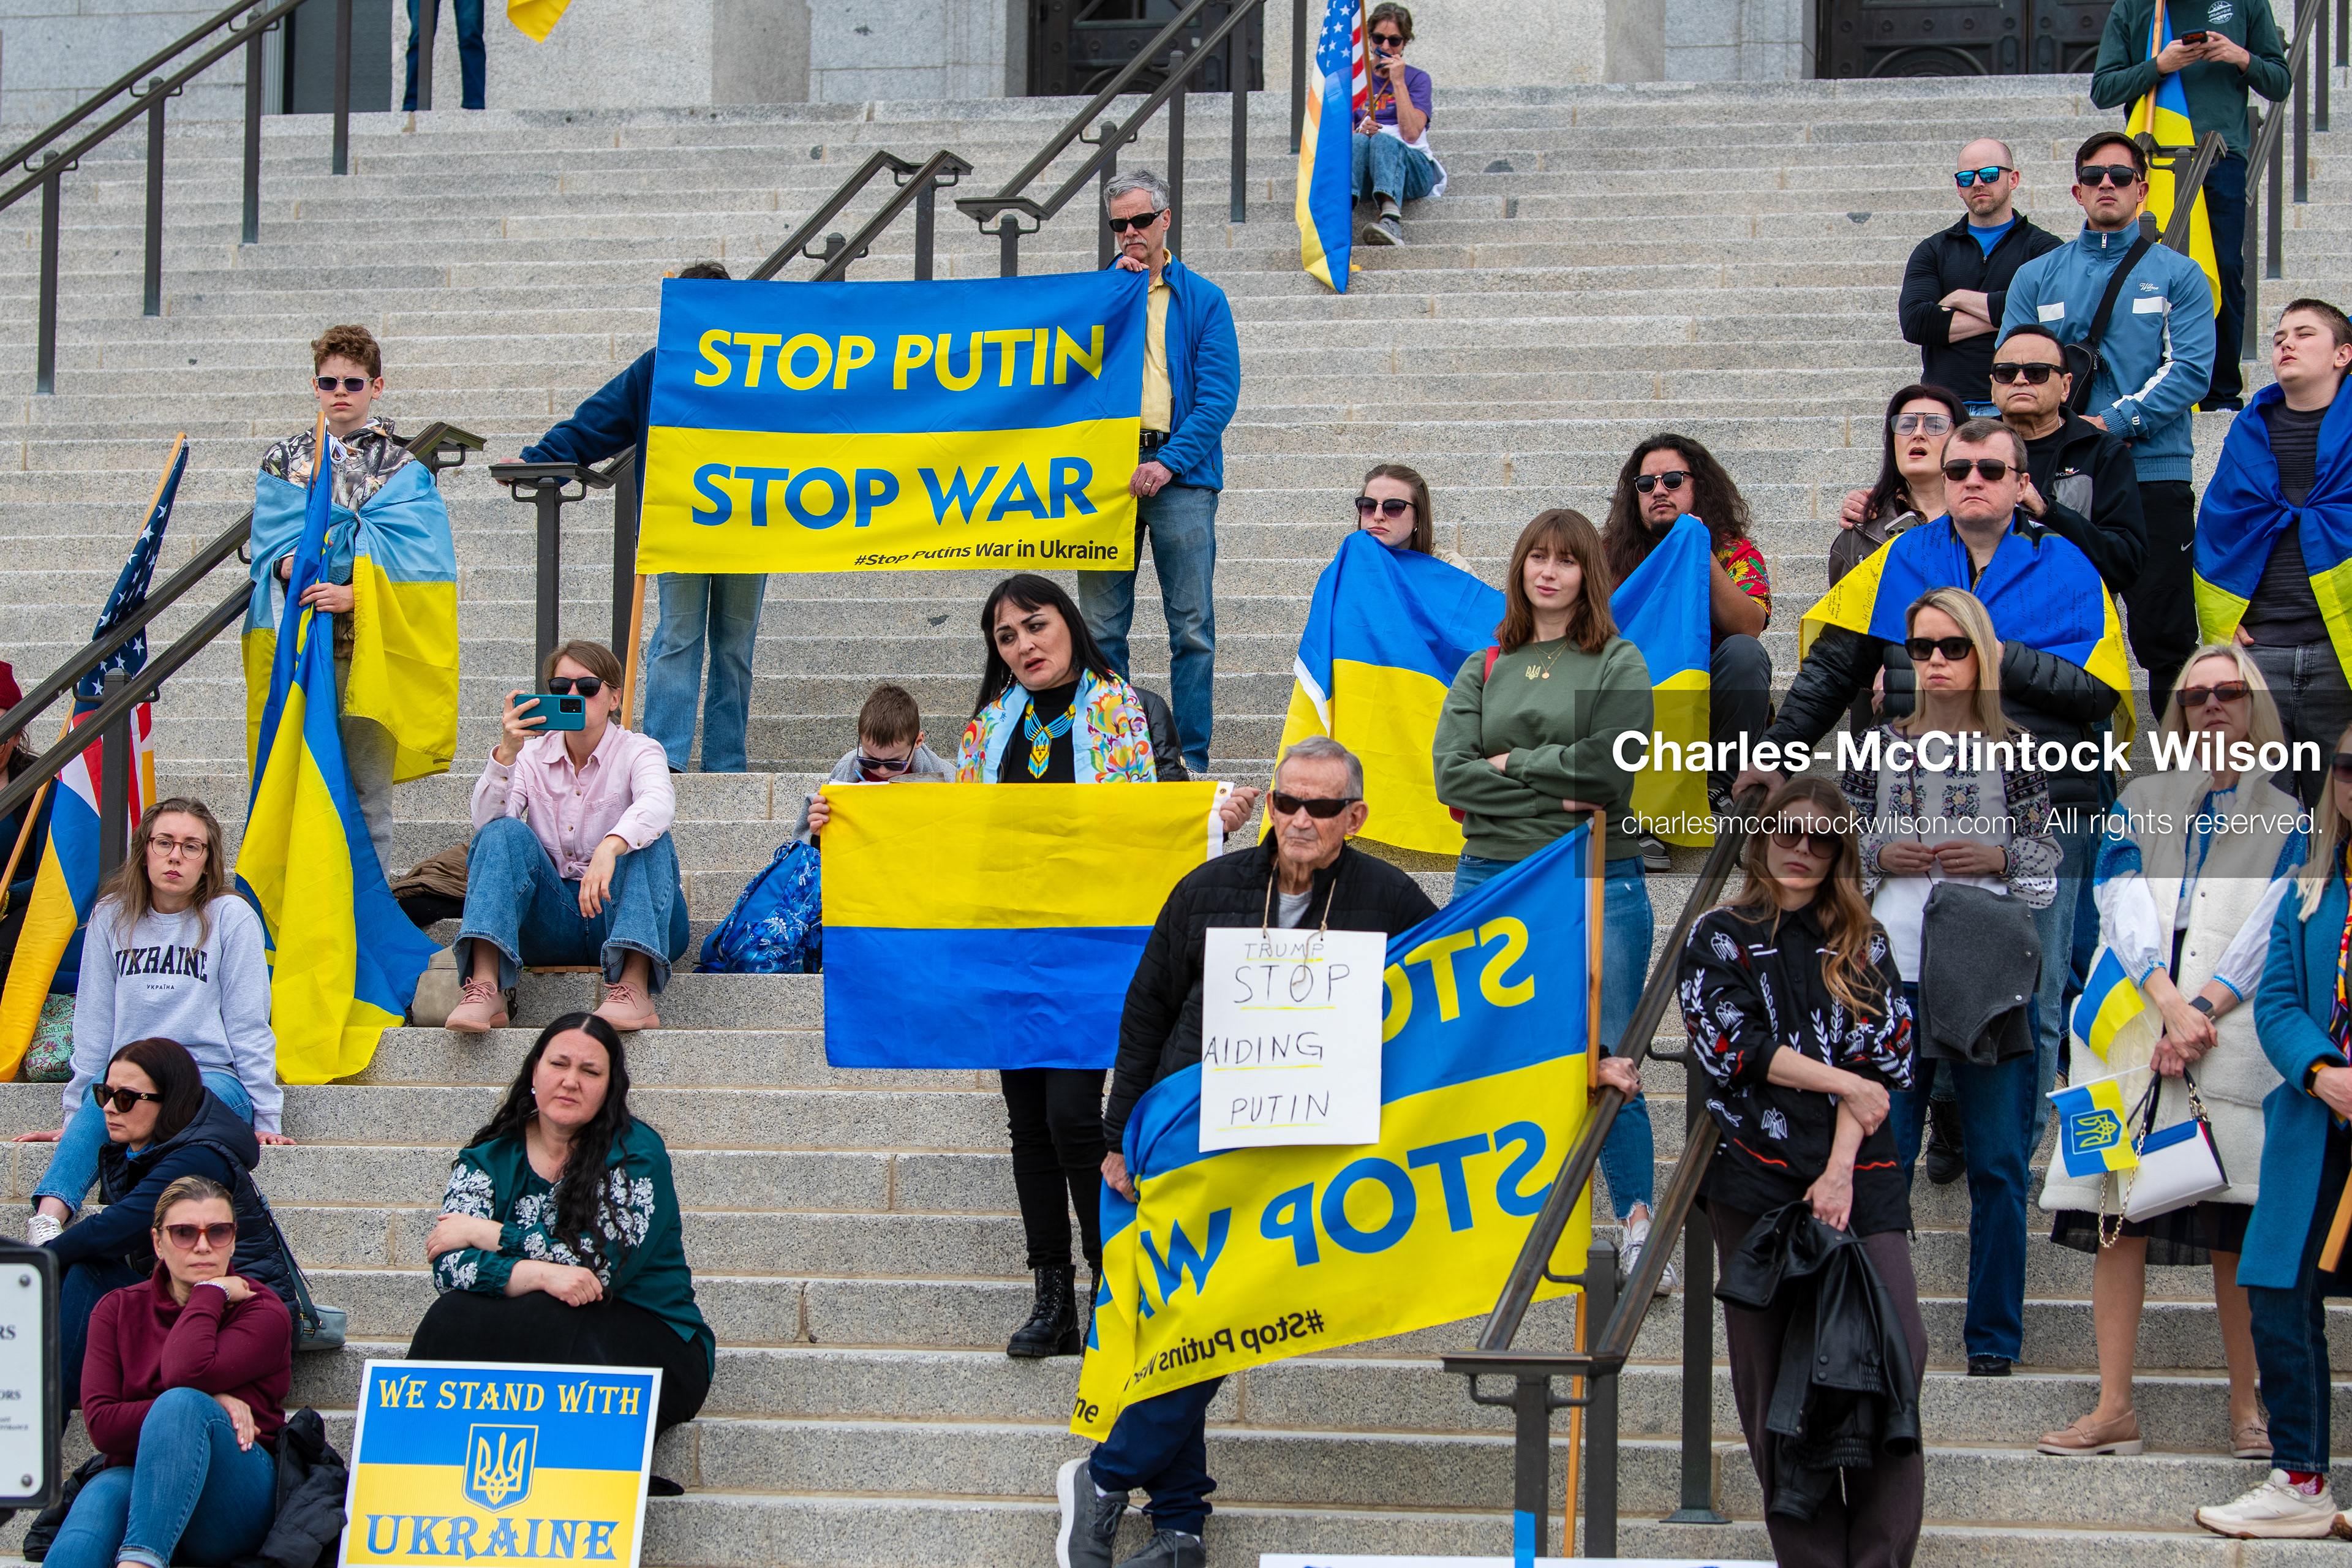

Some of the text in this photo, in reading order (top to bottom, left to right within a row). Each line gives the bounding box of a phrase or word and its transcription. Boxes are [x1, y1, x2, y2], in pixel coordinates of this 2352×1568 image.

[695, 325, 1105, 391] STOP PUTIN
[692, 456, 1099, 530] STOP WAR
[854, 539, 1118, 566] #Stop Putins War in Ukraine
[115, 944, 208, 984] UKRAINE
[1245, 942, 1324, 959] TRUMP
[1234, 963, 1350, 1004] STOP
[41, 1025, 72, 1036] FRIEDEN
[1203, 1031, 1323, 1066] AIDING
[1231, 1090, 1329, 1126] PUTIN
[378, 1374, 642, 1415] WE STAND WITH
[365, 1514, 620, 1561] UKRAINE
